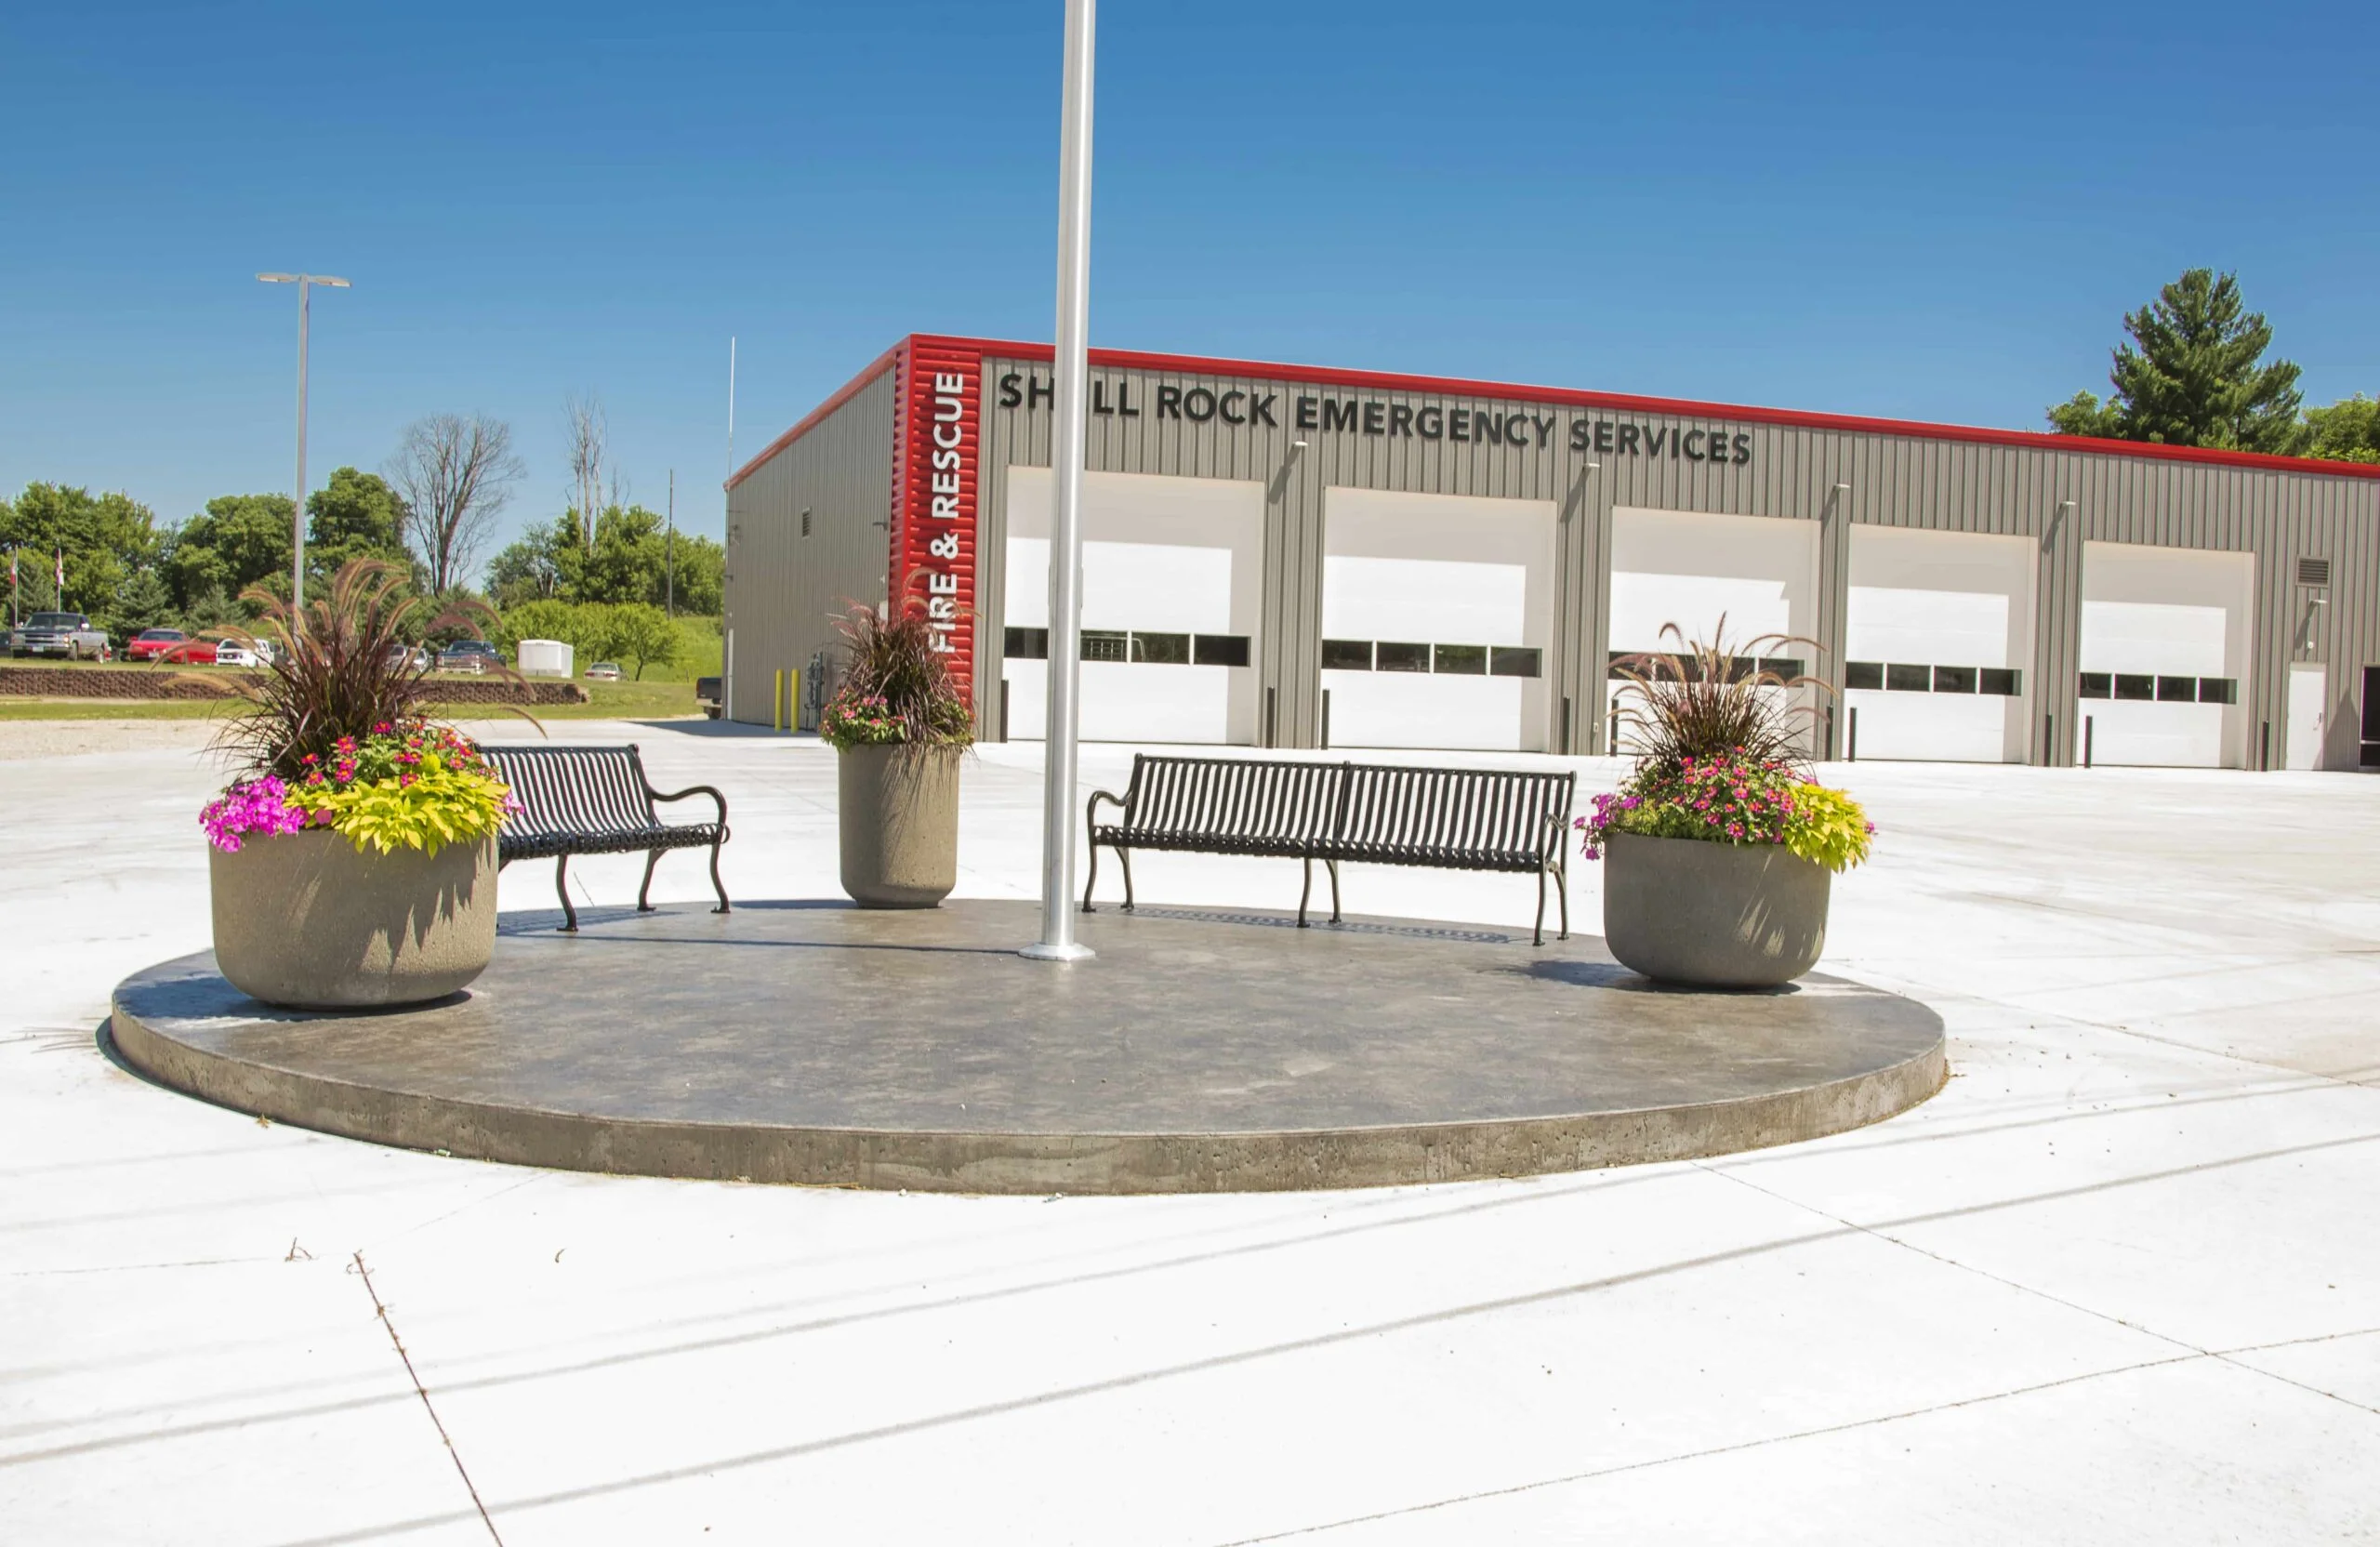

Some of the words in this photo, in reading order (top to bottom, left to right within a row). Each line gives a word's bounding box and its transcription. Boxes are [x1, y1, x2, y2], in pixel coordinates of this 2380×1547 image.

[932, 373, 963, 518] RESCUE
[999, 374, 1140, 416] SHLL
[1157, 386, 1278, 428] ROCK
[1296, 396, 1556, 448] EMERGENCY
[1570, 418, 1751, 464] SERVICES
[930, 533, 959, 560] &
[929, 574, 958, 653] FIRE
